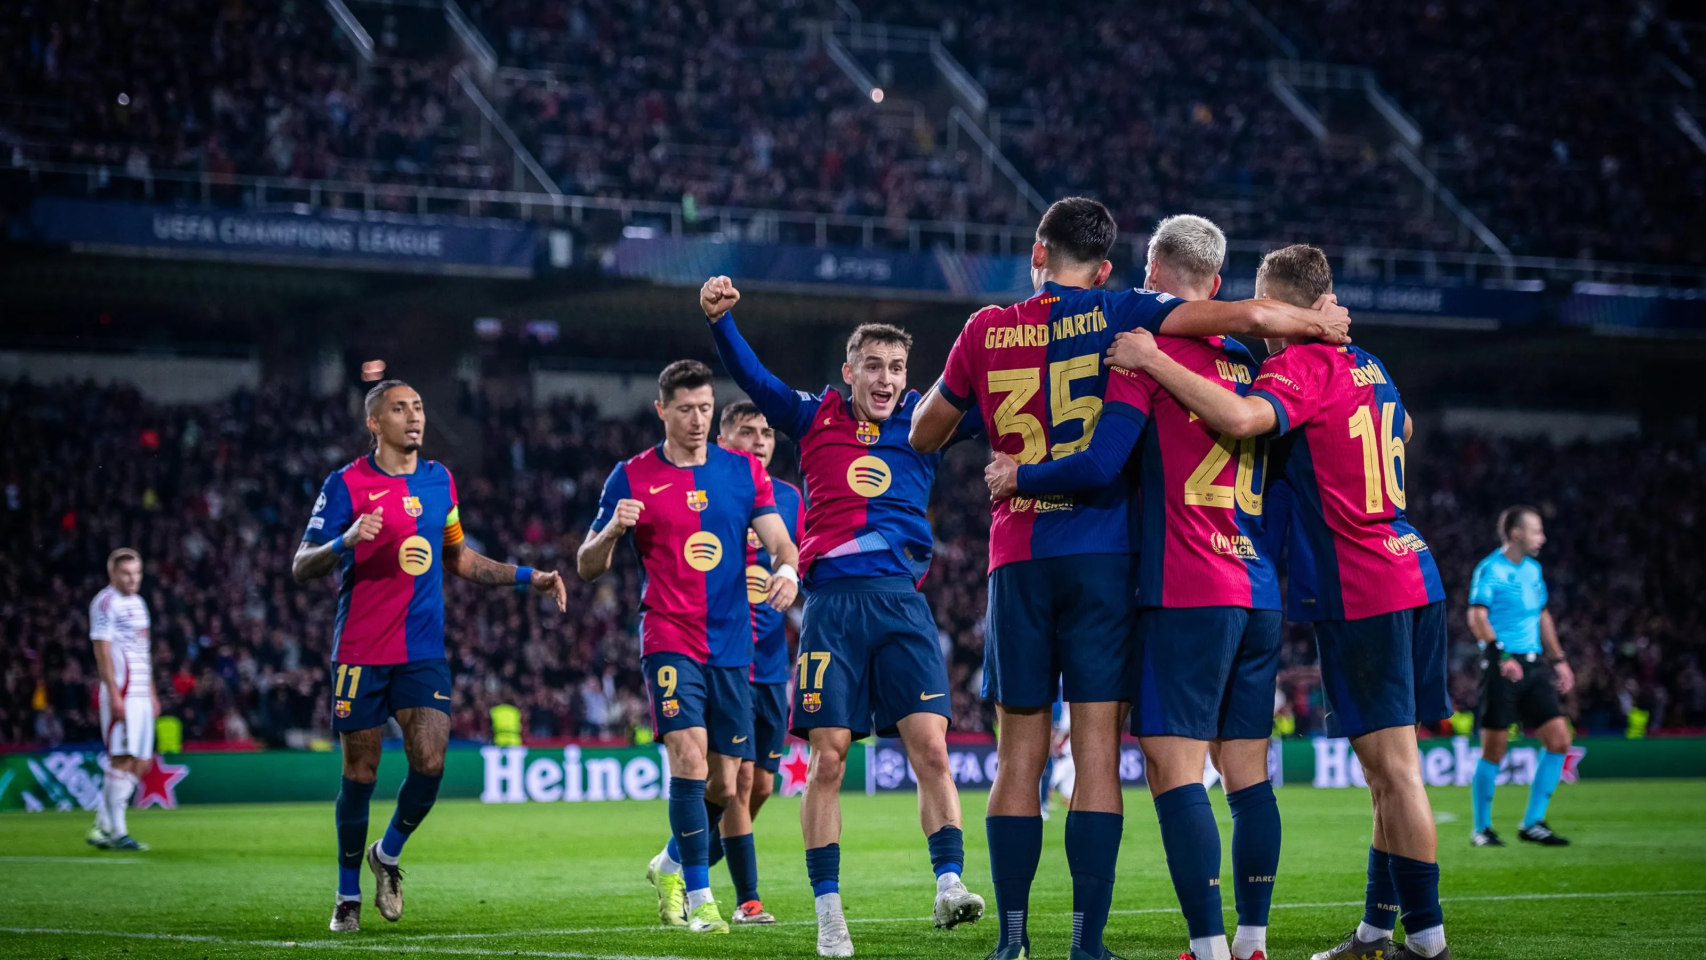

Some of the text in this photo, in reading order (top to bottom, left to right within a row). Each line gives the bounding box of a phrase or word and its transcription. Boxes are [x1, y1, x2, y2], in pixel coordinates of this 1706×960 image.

[153, 213, 443, 256] UEFA CHAMPIONS LEAGUE
[984, 324, 1050, 349] GERARD
[1215, 359, 1252, 385] OLMO
[987, 352, 1103, 465] 35
[1348, 402, 1406, 514] 16
[335, 664, 362, 699] 11
[657, 665, 678, 698] 9
[798, 651, 831, 690] 17
